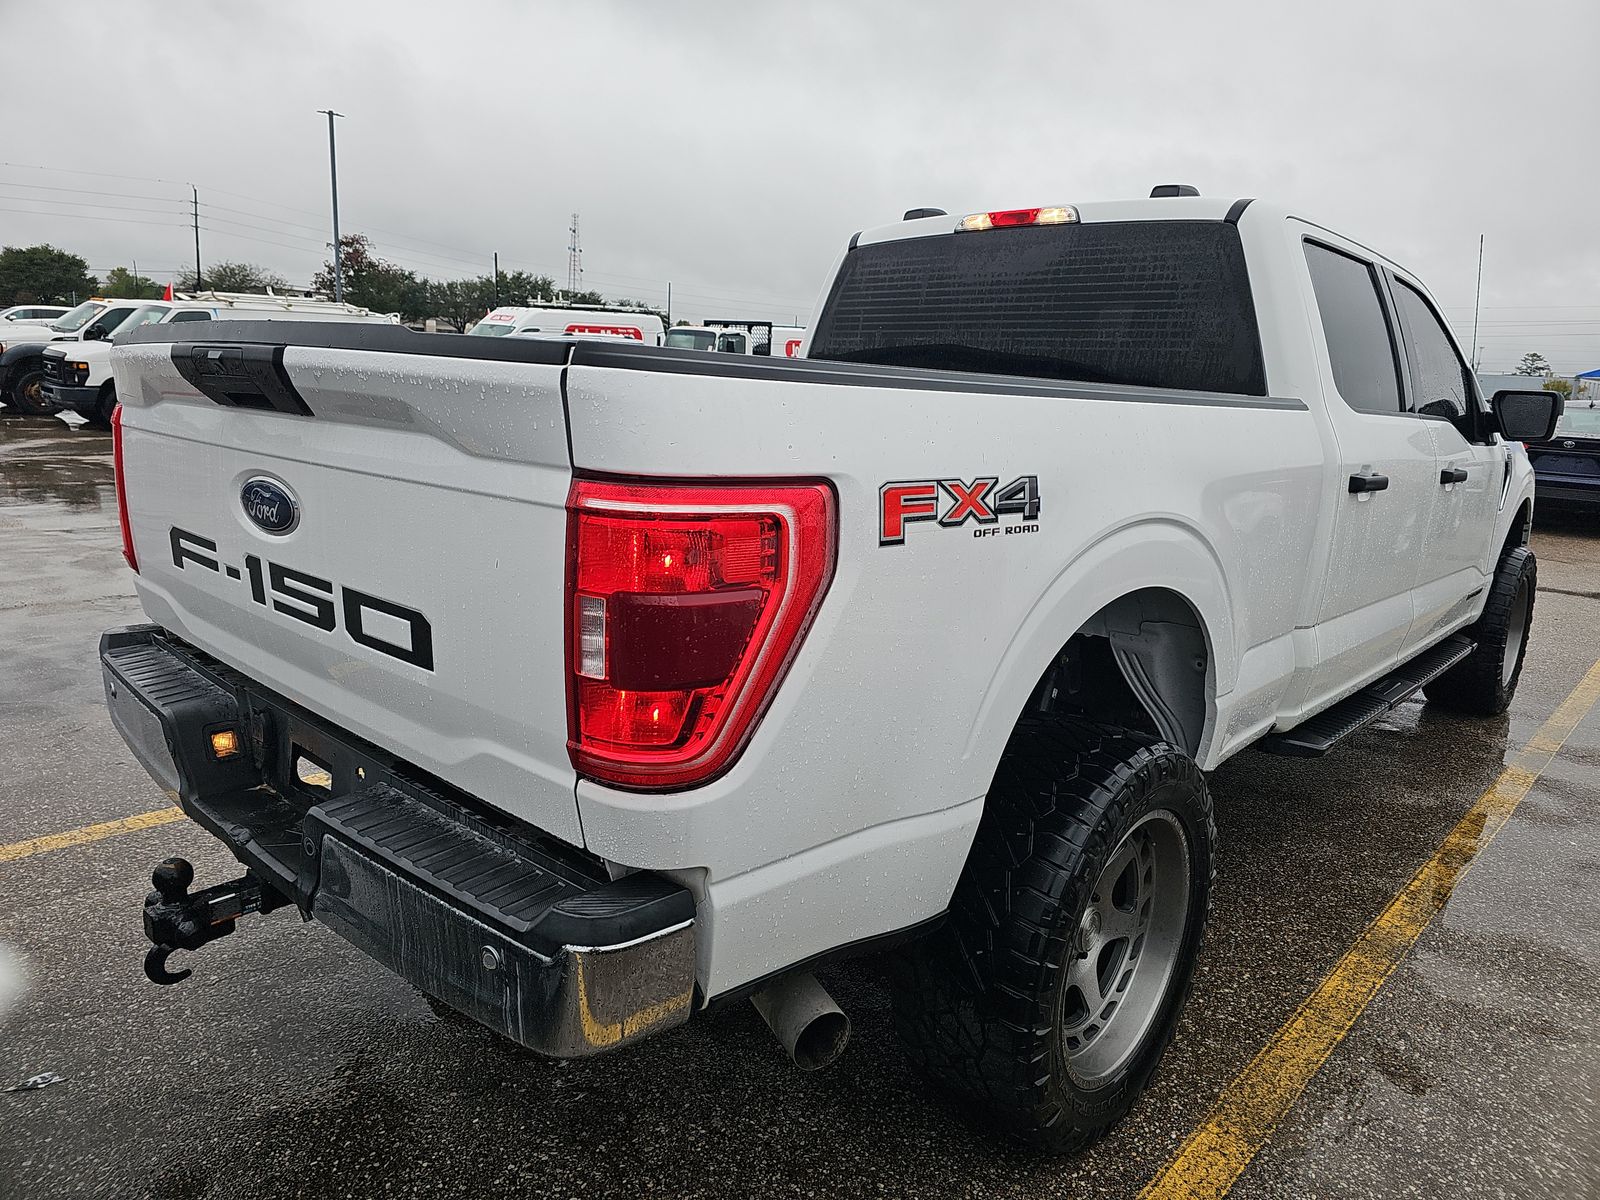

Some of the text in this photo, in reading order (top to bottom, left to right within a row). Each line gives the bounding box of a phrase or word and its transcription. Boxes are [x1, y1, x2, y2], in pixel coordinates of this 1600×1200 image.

[247, 487, 280, 523] Ford
[879, 476, 1040, 546] FX4
[973, 524, 1039, 538] OFF ROAD
[169, 525, 435, 672] F-150
